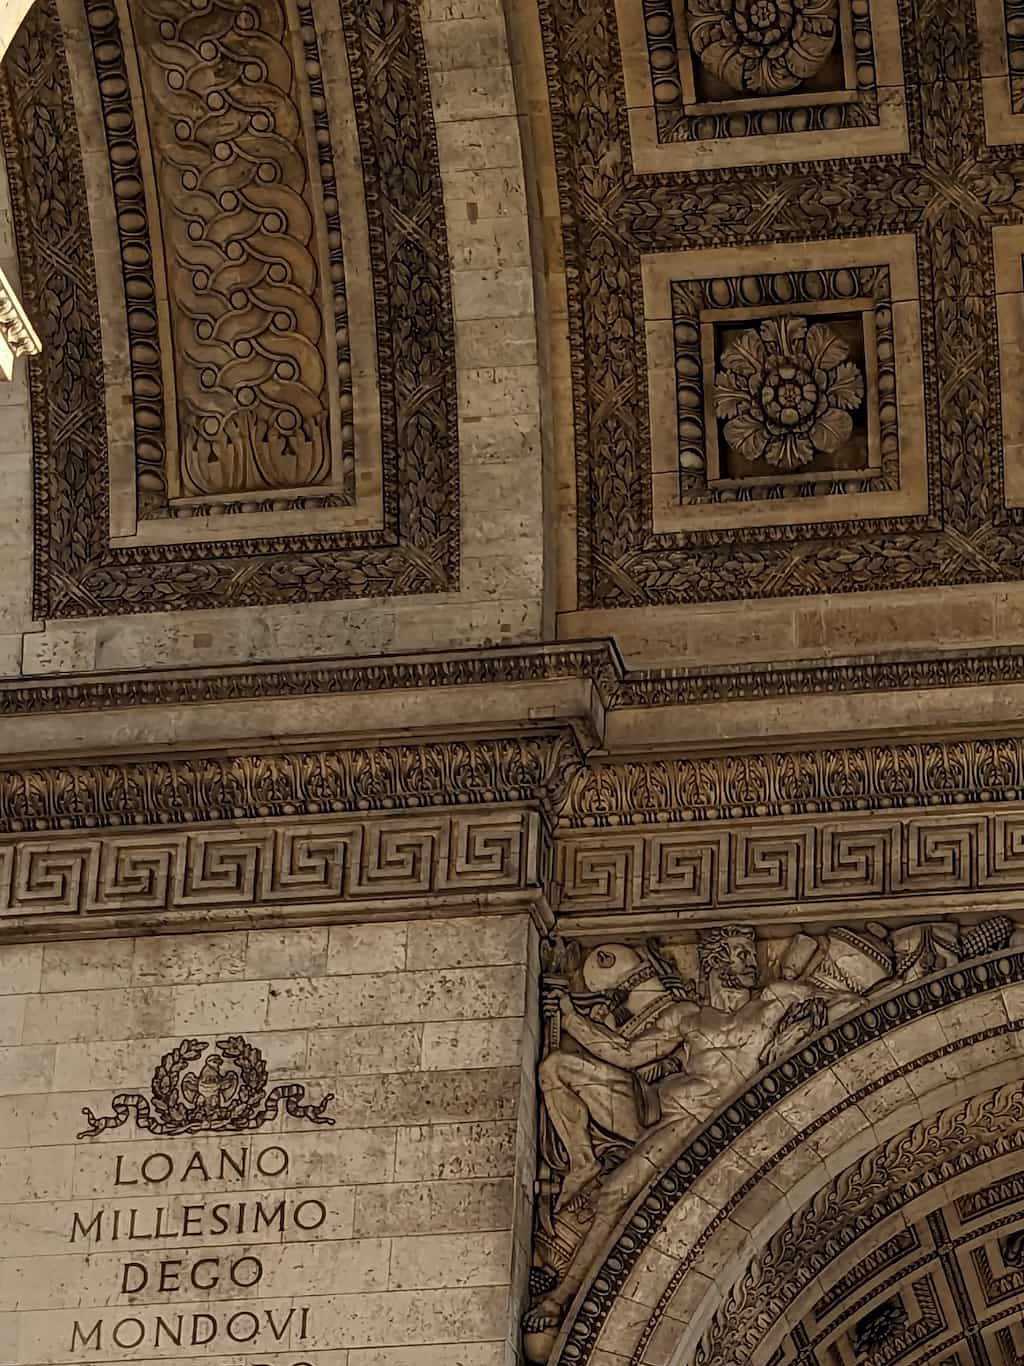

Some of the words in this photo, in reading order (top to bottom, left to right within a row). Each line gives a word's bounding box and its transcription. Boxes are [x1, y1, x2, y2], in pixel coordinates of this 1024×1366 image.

[114, 1145, 289, 1187] LOANO
[69, 1199, 327, 1243] MILLESIMO
[121, 1256, 264, 1295] DEGO
[70, 1307, 311, 1352] MONDOVI
